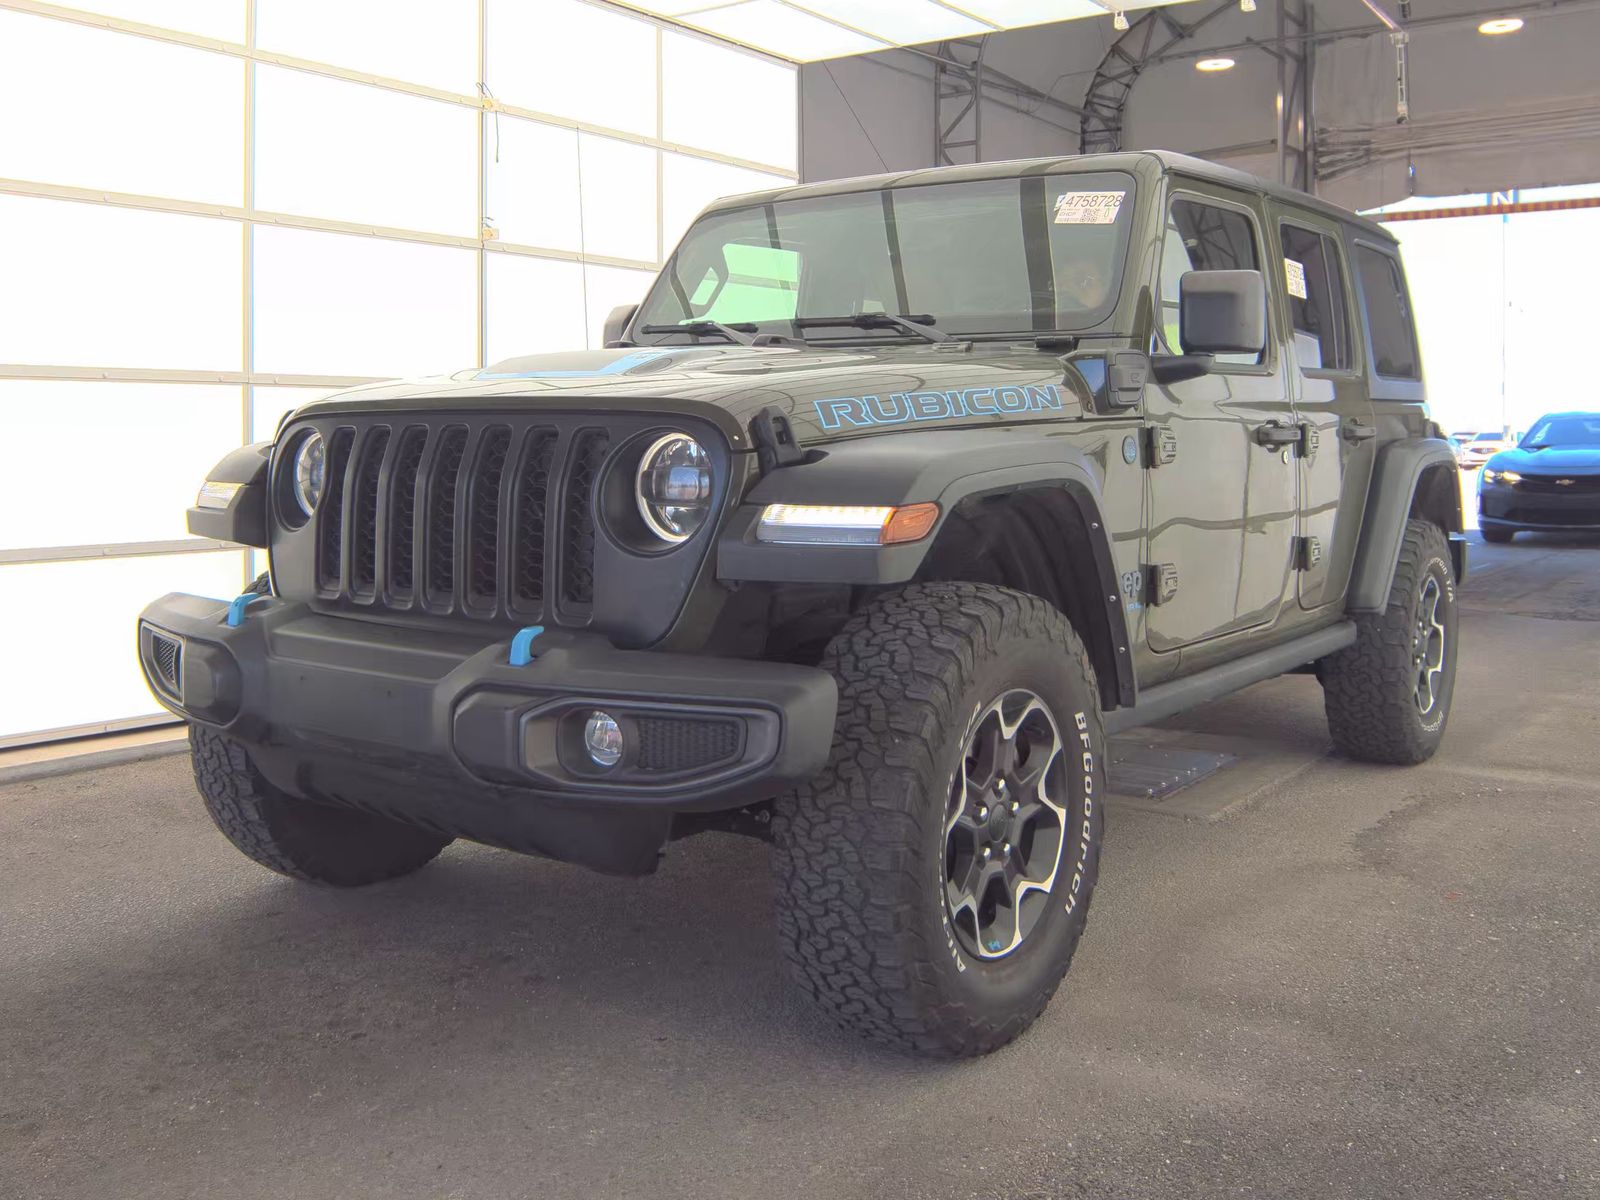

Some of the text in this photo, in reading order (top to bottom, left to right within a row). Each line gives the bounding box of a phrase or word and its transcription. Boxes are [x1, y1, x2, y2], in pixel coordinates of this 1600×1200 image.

[1065, 194, 1123, 208] 4758728
[814, 385, 1062, 429] RUBICON
[1064, 711, 1093, 916] BFGoodrich
